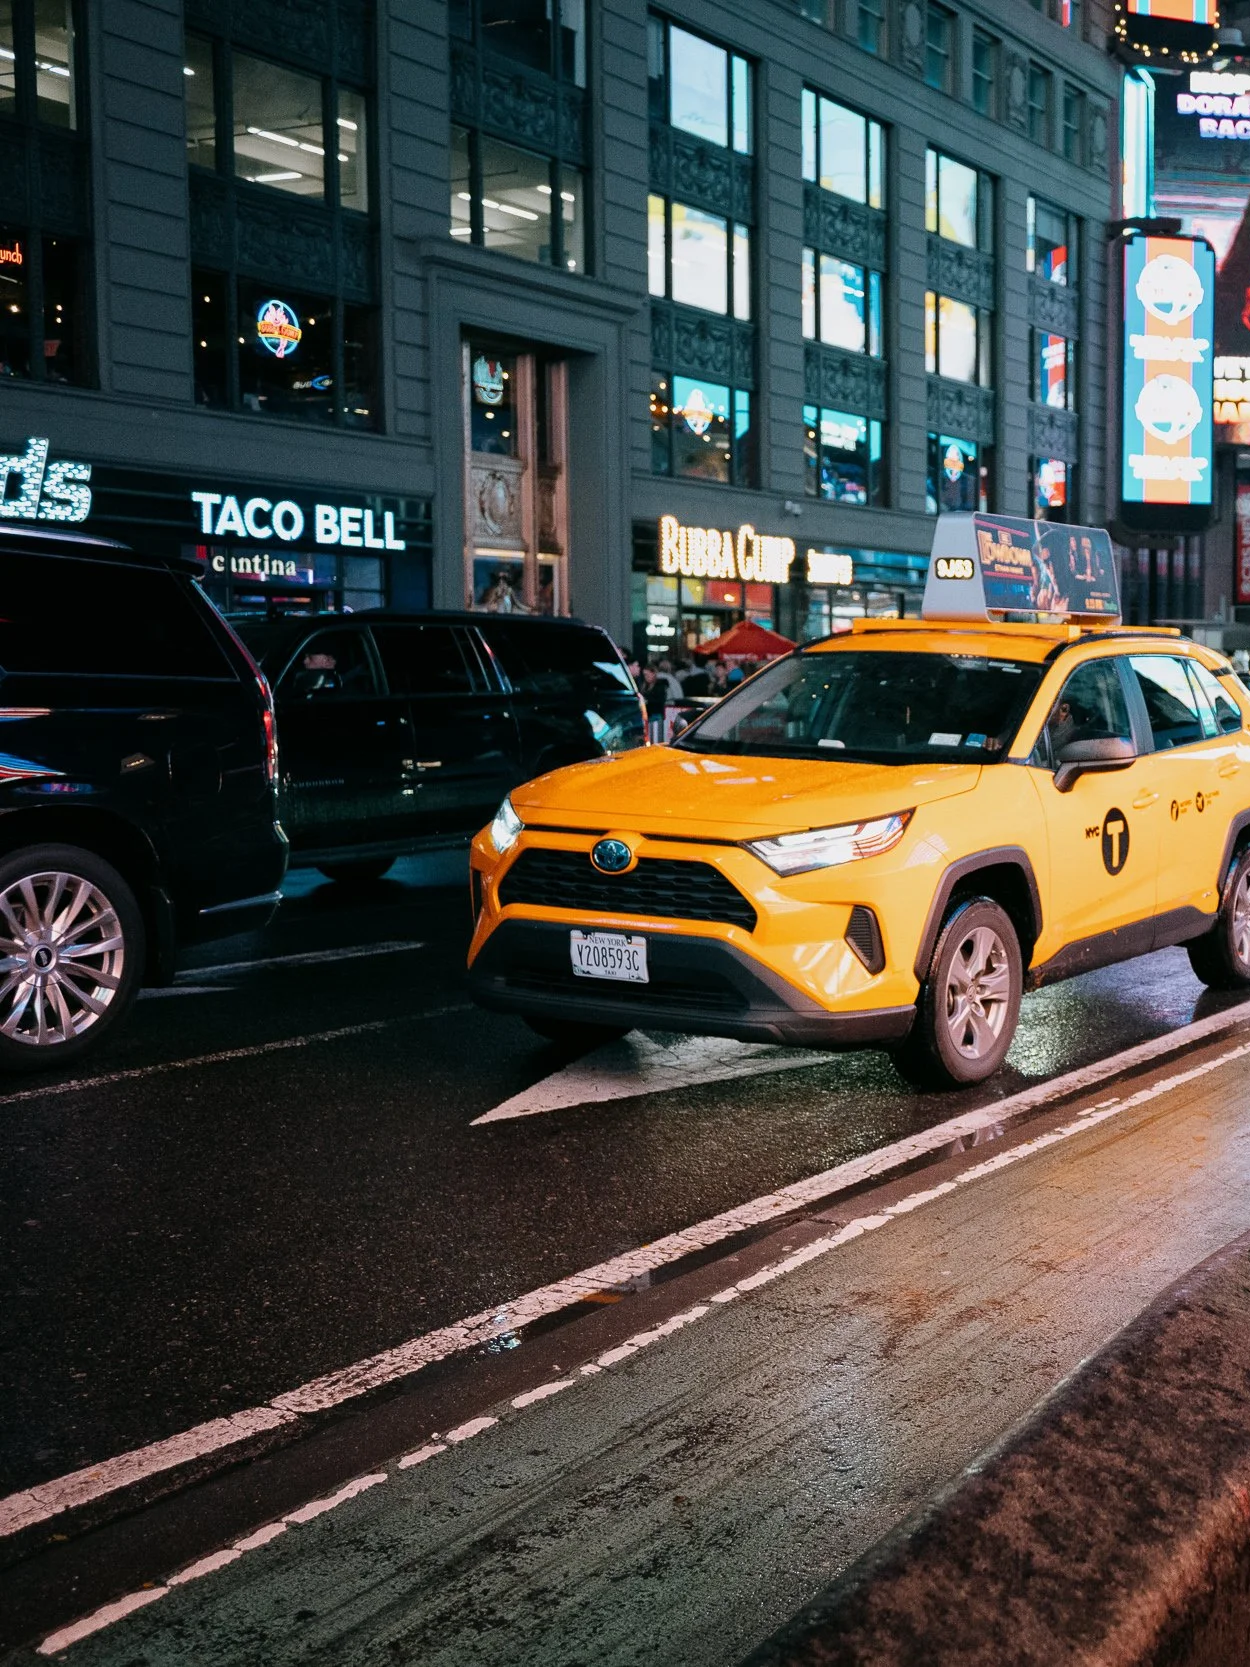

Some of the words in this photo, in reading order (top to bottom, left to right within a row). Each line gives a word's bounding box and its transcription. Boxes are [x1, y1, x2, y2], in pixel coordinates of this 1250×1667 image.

[0, 242, 23, 265] unch
[191, 491, 305, 541] TACO
[315, 503, 406, 551] BELL
[659, 514, 737, 580] BUBBA
[1085, 826, 1100, 839] NYC
[589, 936, 606, 945] NEW
[607, 938, 627, 947] YORK
[577, 943, 640, 972] Y208593C
